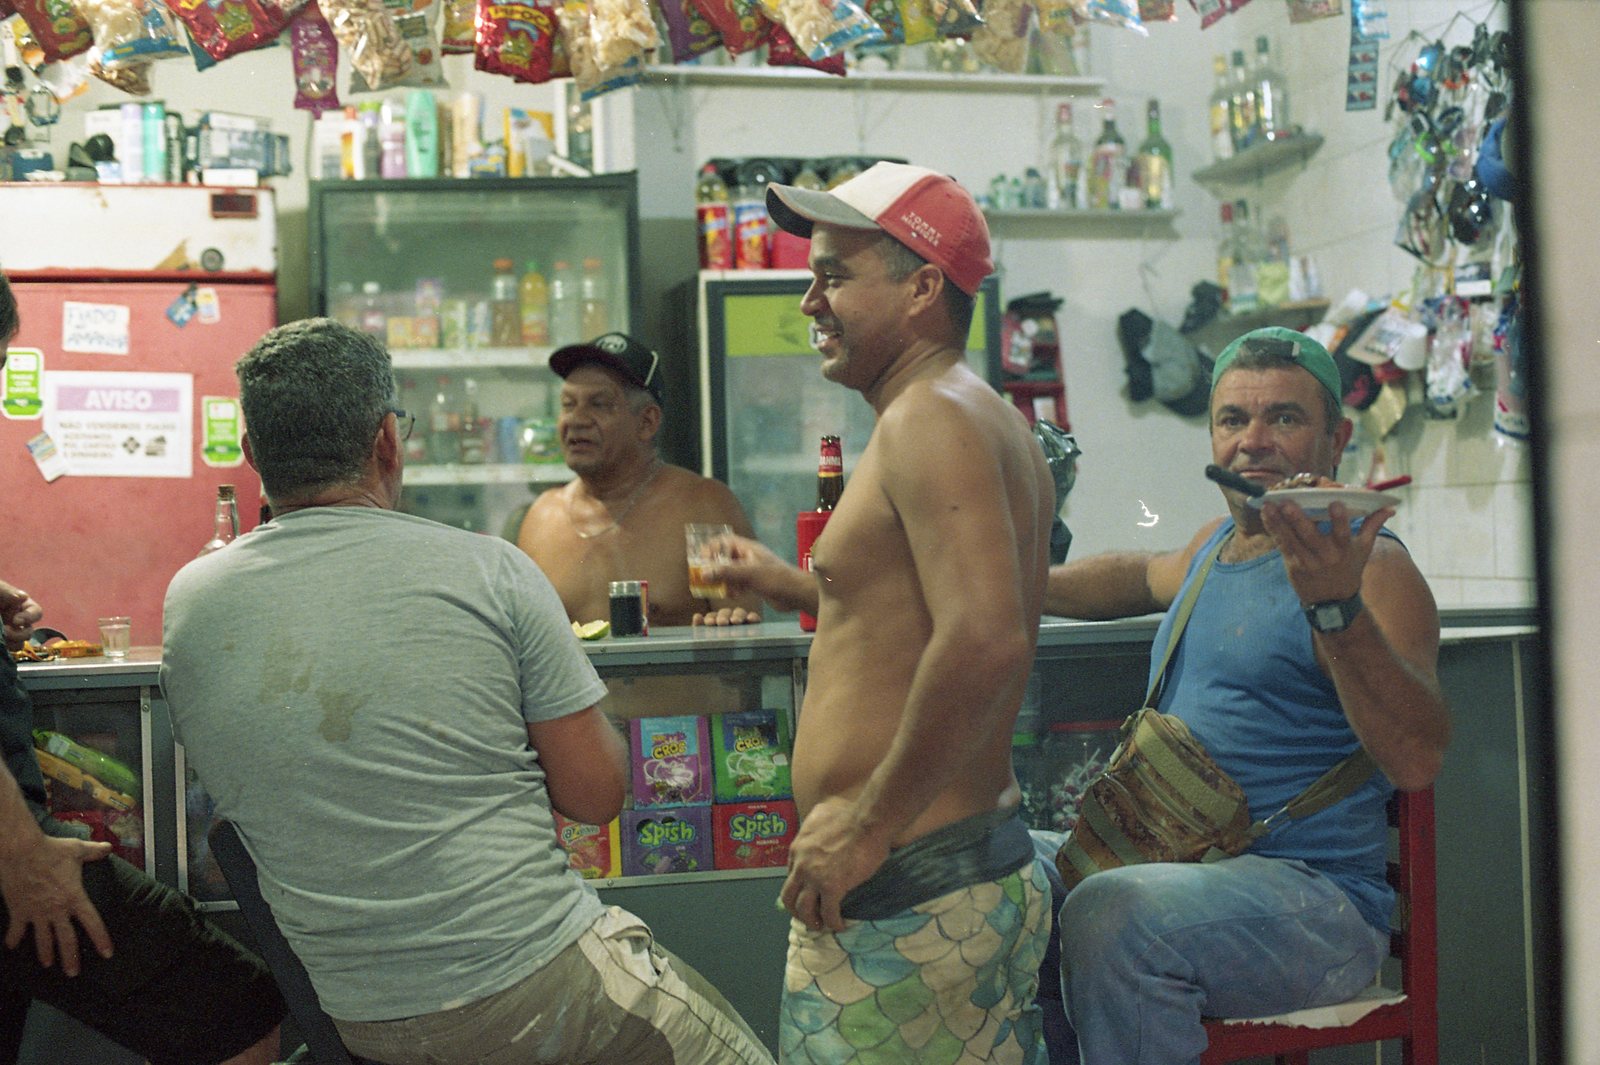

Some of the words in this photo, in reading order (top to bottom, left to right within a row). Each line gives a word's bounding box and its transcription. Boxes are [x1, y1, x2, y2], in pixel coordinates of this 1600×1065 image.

[909, 211, 942, 239] TOMMY
[84, 388, 153, 410] AVISO
[819, 456, 841, 466] RAHMA
[640, 819, 695, 846] Spish
[732, 813, 786, 841] Spish
